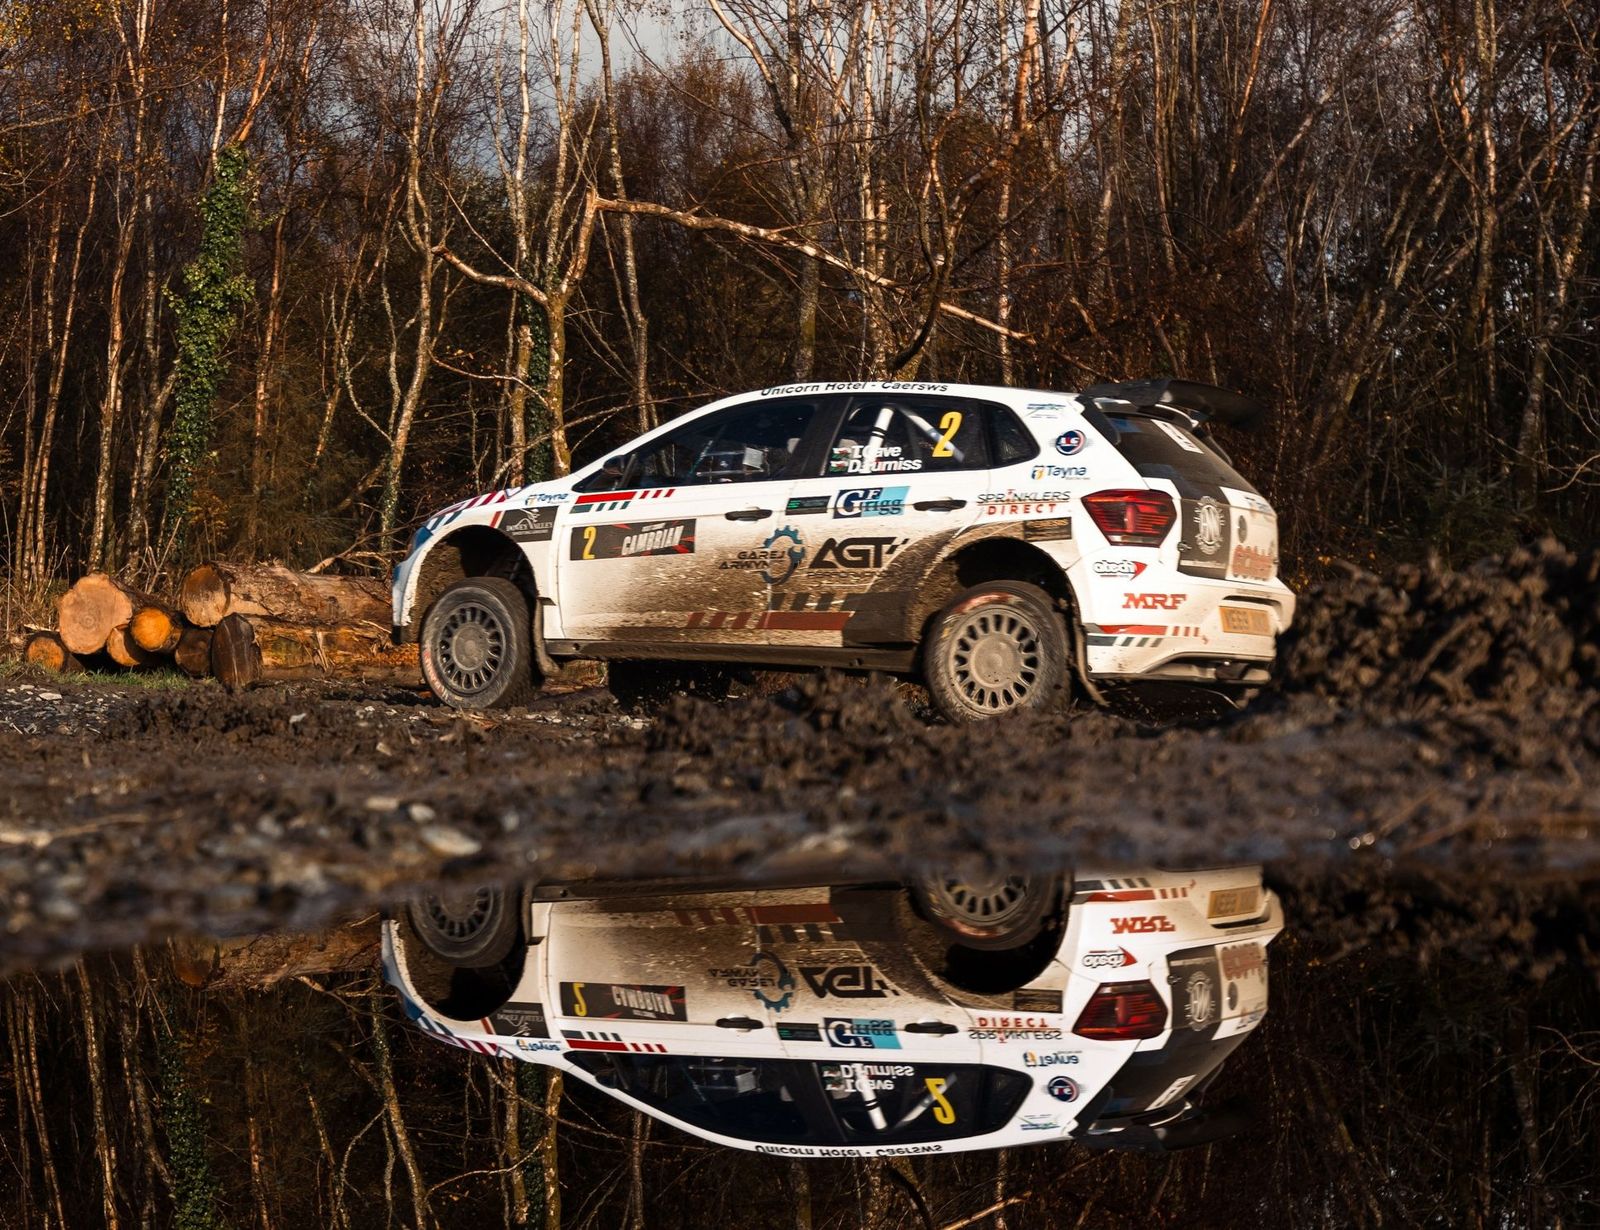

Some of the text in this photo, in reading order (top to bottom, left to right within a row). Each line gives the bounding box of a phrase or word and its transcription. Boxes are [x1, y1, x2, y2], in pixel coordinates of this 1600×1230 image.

[761, 383, 819, 396] Unicorn
[825, 382, 867, 391] Hotel
[881, 382, 949, 392] Caersws
[932, 411, 962, 458] 2
[1046, 465, 1087, 479] Tayna
[987, 504, 1057, 515] DIRECT
[582, 526, 597, 560] 2
[737, 551, 785, 560] GAREJ
[808, 537, 901, 569] AGT
[1121, 593, 1187, 610] MRF
